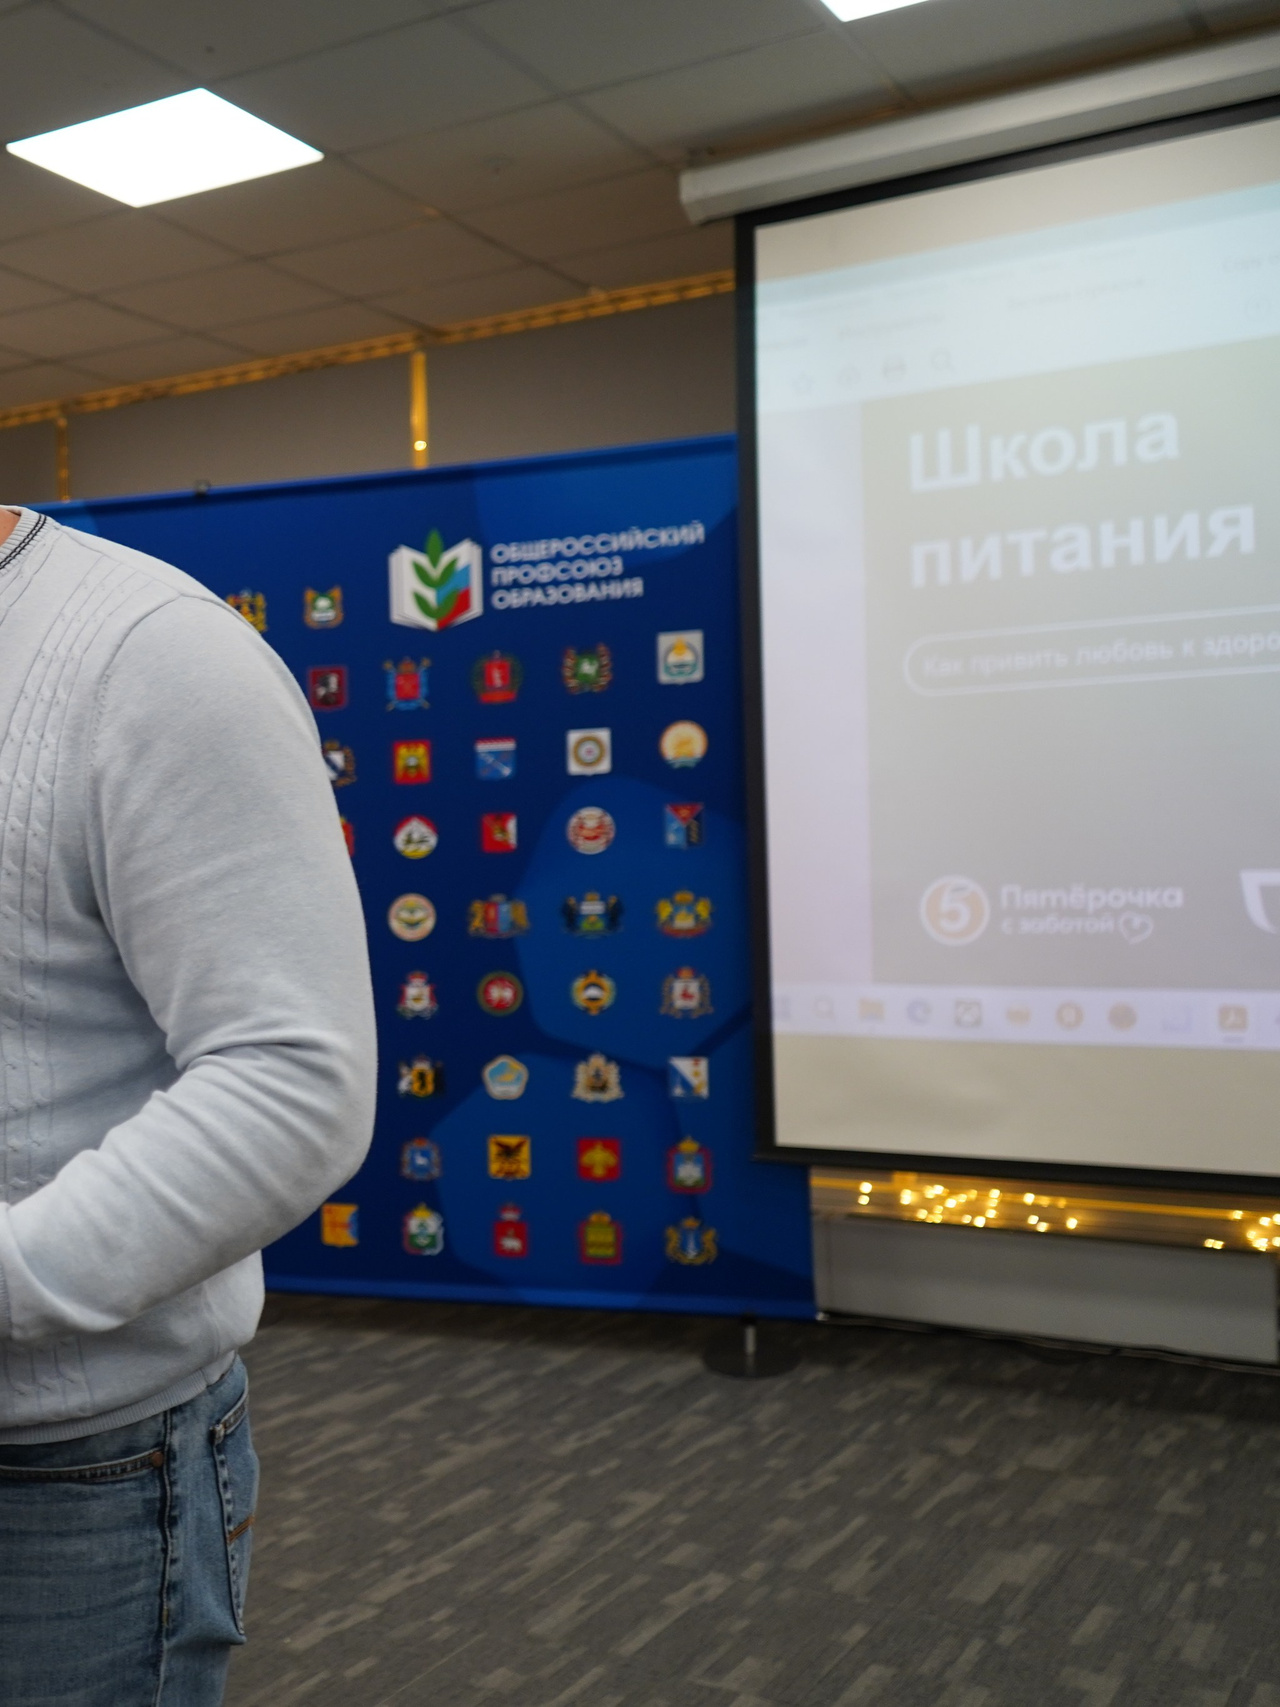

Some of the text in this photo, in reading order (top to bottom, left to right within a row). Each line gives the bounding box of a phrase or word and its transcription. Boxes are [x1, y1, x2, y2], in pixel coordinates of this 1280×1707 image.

[908, 410, 1181, 493] Школа
[490, 519, 706, 564] ОБЩЕРОССИЙСКИЙ
[910, 503, 1256, 589] питания
[491, 555, 624, 587] ПРОФСОЮЗ
[491, 576, 644, 610] ОБРАЗОВАНИЯ
[922, 656, 964, 678] Как
[1074, 637, 1174, 667] любовь
[1181, 638, 1195, 658] к
[1000, 882, 1184, 914] Пятёрочка
[1018, 913, 1115, 935] заботой
